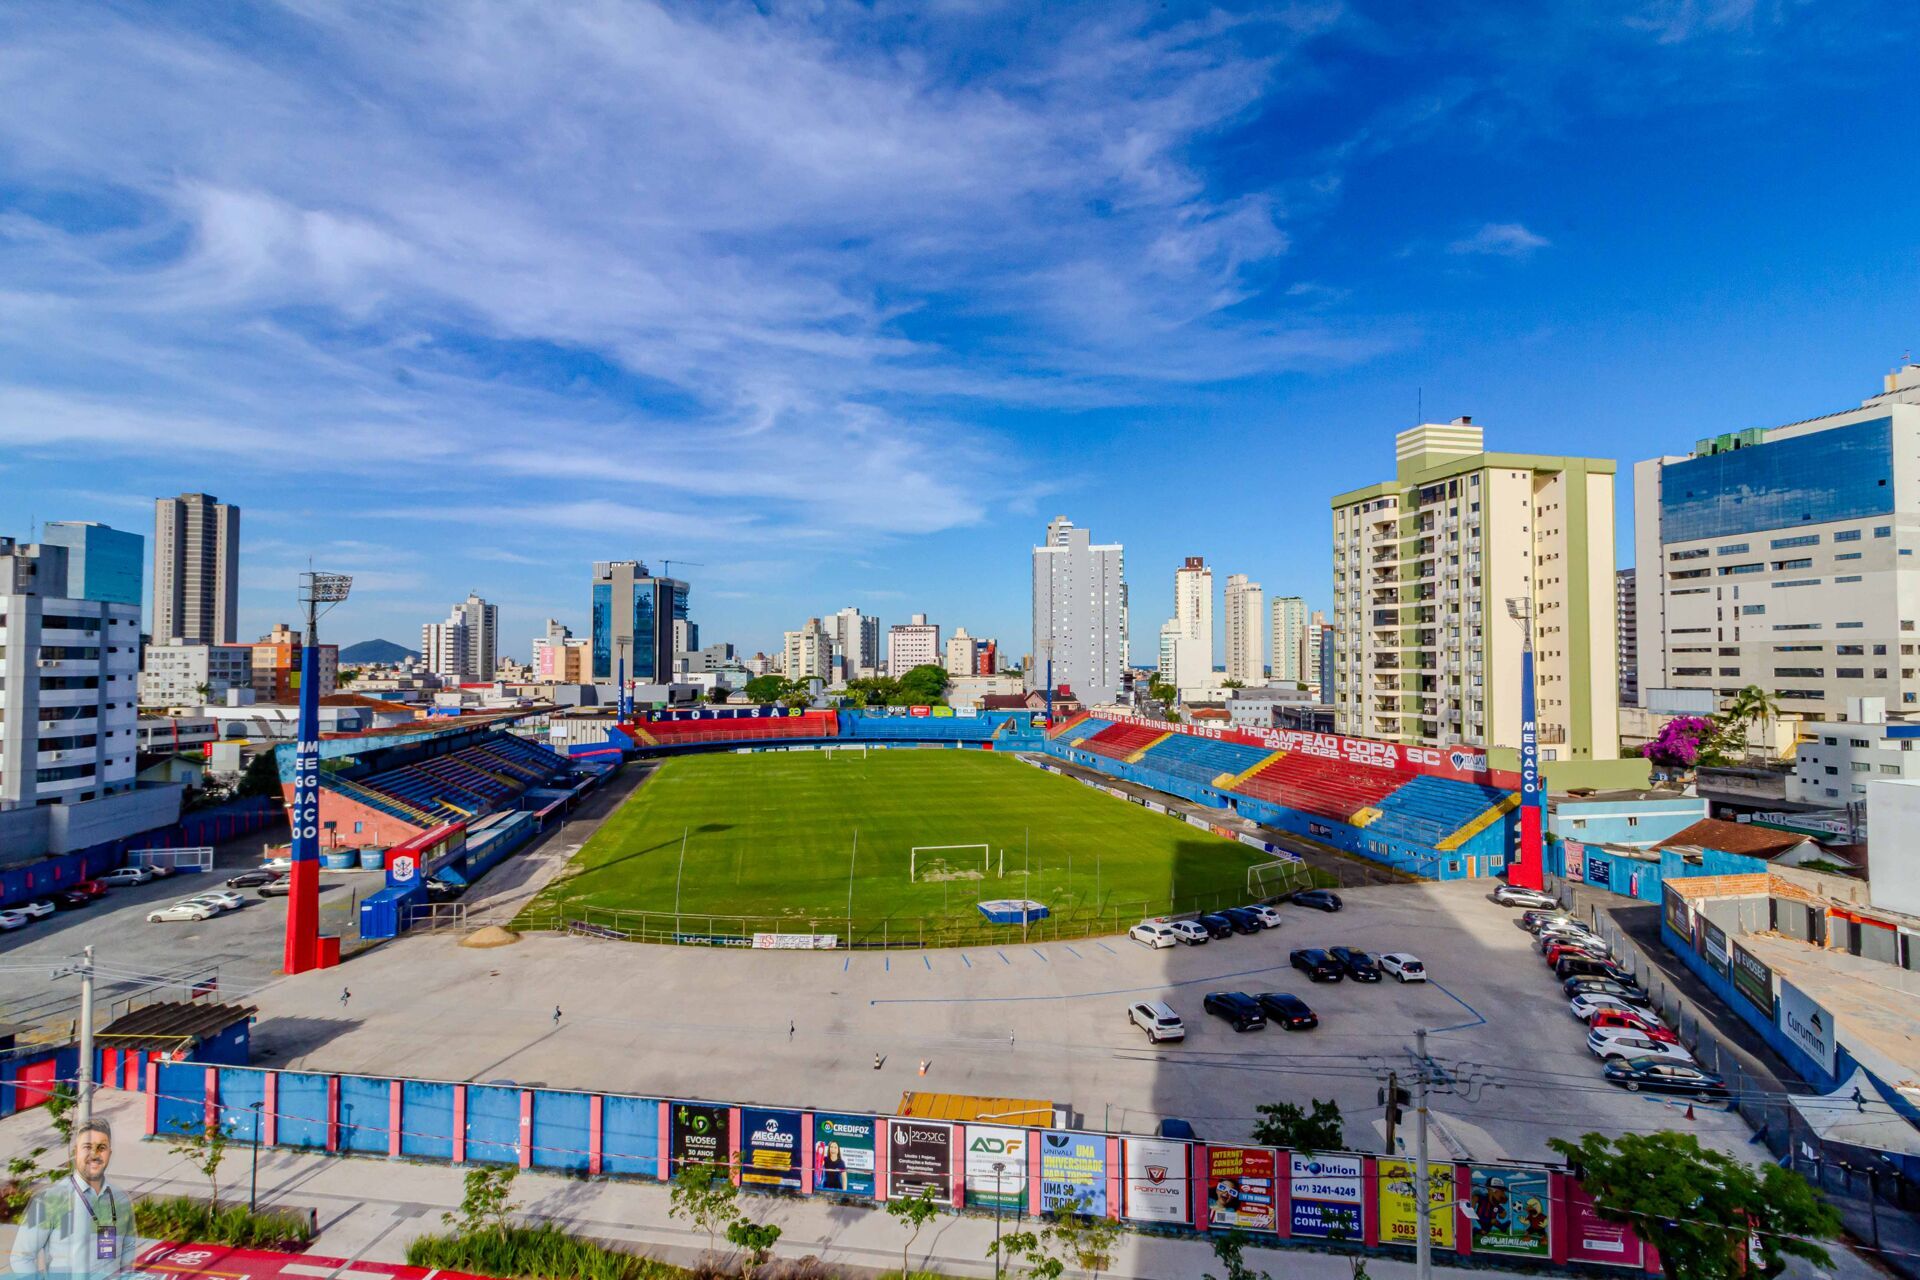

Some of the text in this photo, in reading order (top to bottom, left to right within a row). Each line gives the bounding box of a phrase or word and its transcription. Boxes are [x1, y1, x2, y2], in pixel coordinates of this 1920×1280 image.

[672, 709, 780, 721] LOTISA
[1124, 716, 1188, 734] CATARINENSE
[1192, 727, 1222, 739] 1963
[1343, 738, 1399, 760] COPA
[1406, 748, 1441, 766] SC
[303, 740, 318, 839] MEGAÇO
[1741, 953, 1766, 982] EVOSEG
[1787, 1011, 1825, 1056] Curumim
[833, 1123, 870, 1135] CREDIFOZ
[685, 1135, 717, 1145] EVOSEG
[911, 1130, 946, 1142] PROSPEC
[969, 1136, 1022, 1155] ADF
[1043, 1148, 1072, 1156] UNIVALI
[1076, 1145, 1095, 1158] UMA
[697, 1149, 714, 1157] ANOS
[1212, 1149, 1243, 1160] INTERNET
[1043, 1156, 1104, 1173] UNIVERSIDADE
[1211, 1166, 1243, 1176] DIVERSÃO
[1294, 1161, 1357, 1175] Evolution
[1043, 1169, 1066, 1182] PARA
[1043, 1182, 1061, 1196] UMA
[1134, 1185, 1180, 1196] PORTOVIG
[1294, 1184, 1356, 1197] (47) 3241-4249
[1295, 1205, 1338, 1217] ALUGEL
